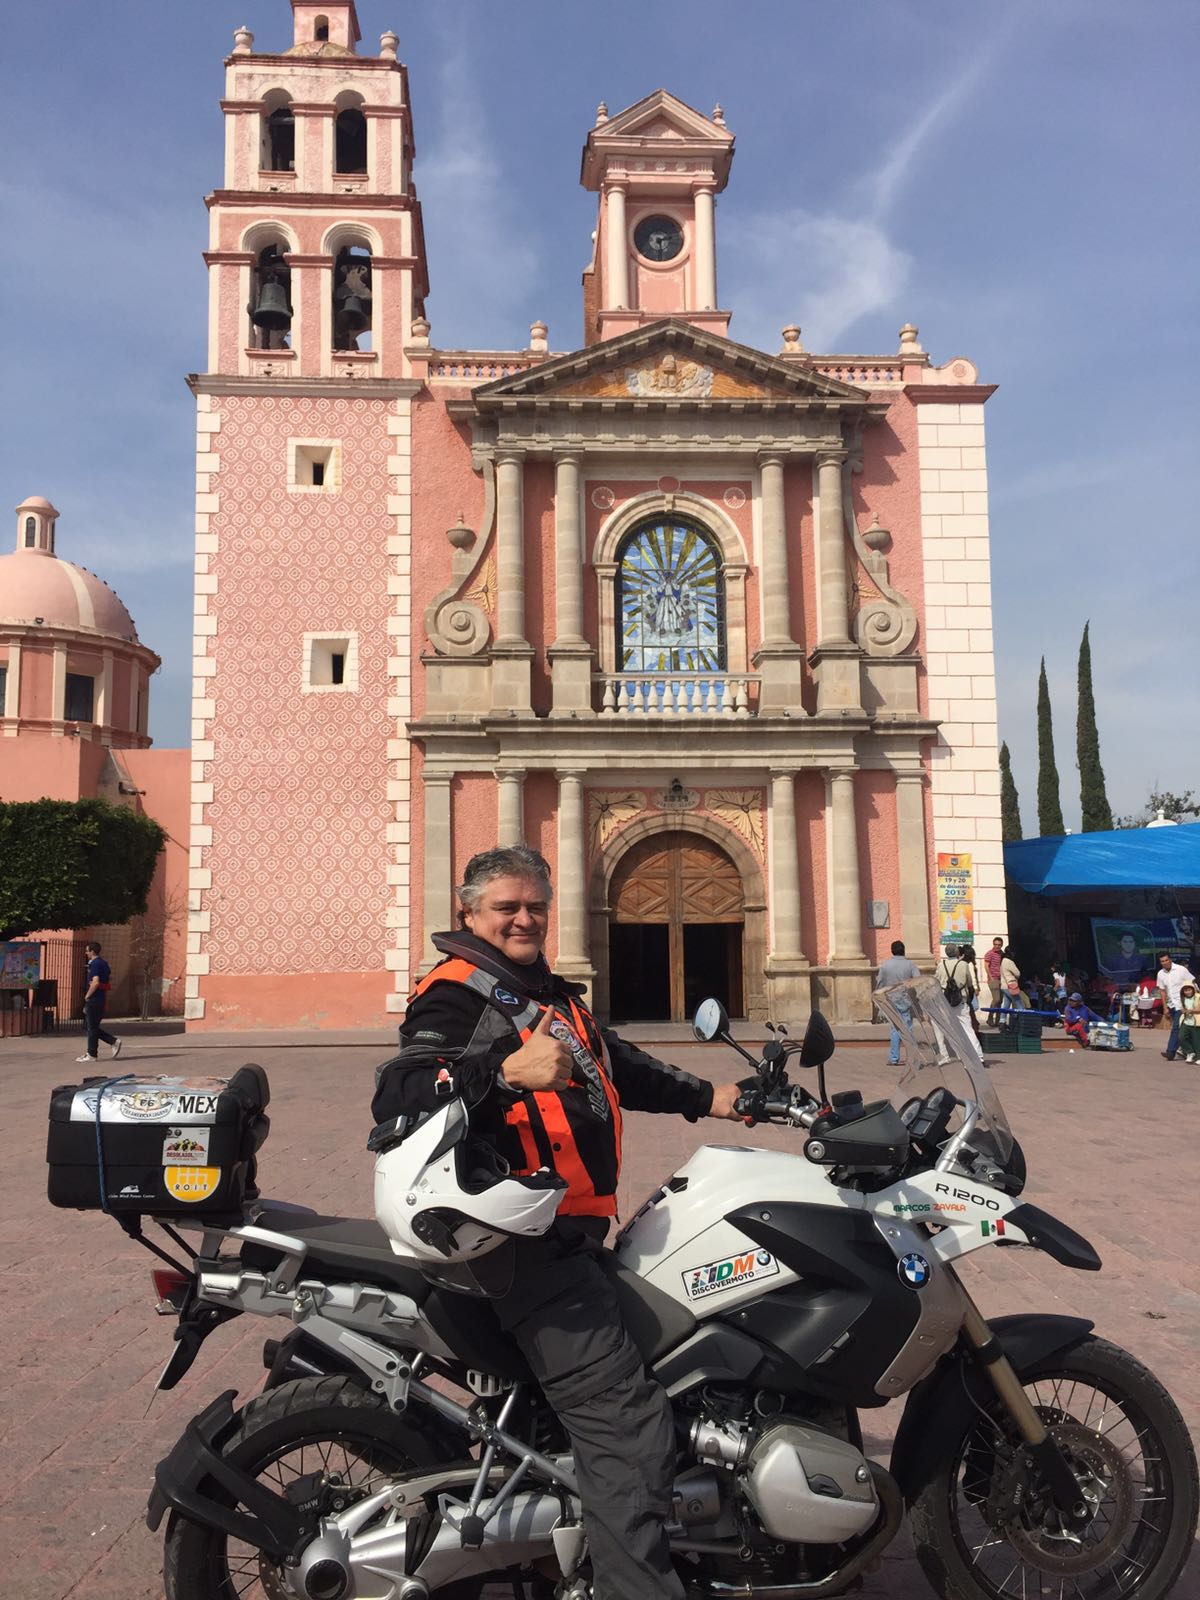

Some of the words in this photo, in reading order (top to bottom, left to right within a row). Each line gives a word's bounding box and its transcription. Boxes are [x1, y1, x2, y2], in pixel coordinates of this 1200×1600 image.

[177, 1096, 218, 1114] MEX
[936, 1183, 948, 1195] R
[952, 1188, 1000, 1211] 1200
[893, 1204, 930, 1212] MARCOS
[933, 1203, 966, 1211] ZAVALA
[902, 1254, 928, 1268] BMW
[691, 1271, 755, 1296] DISCOVERMOTO
[1013, 1482, 1022, 1506] BMW
[298, 1499, 319, 1513] BMW
